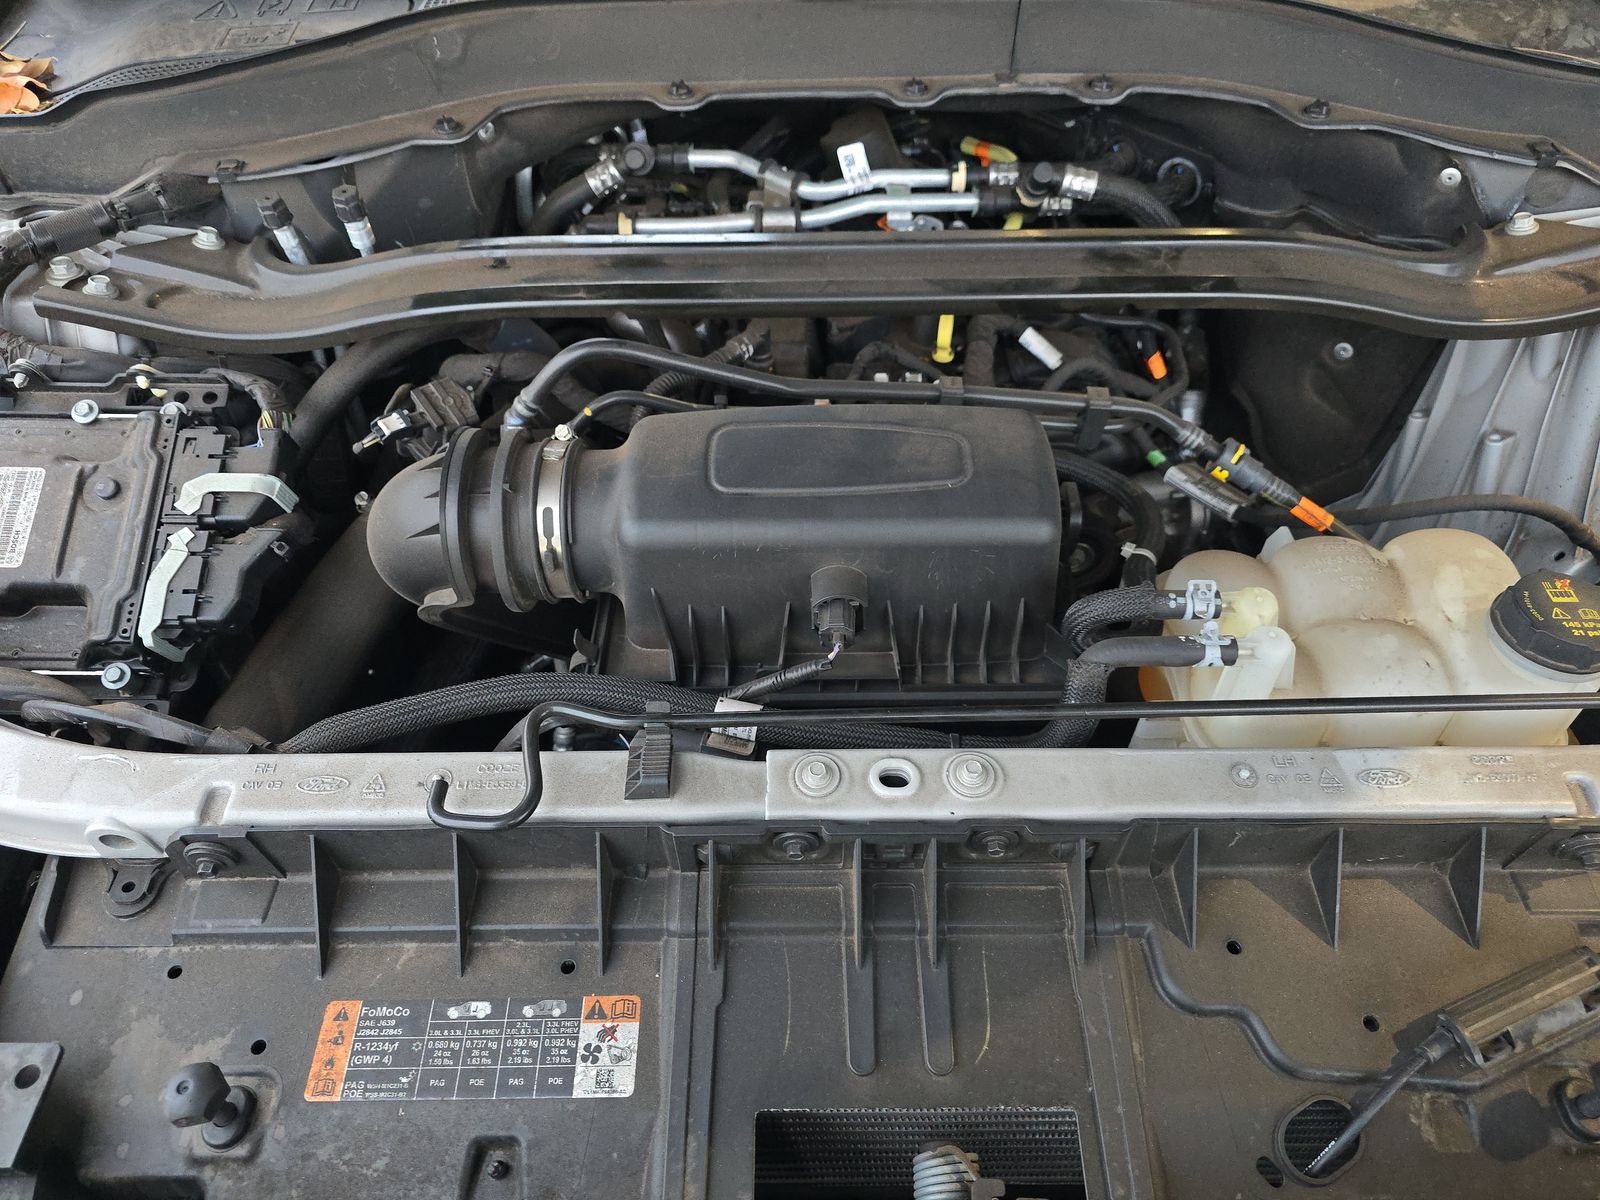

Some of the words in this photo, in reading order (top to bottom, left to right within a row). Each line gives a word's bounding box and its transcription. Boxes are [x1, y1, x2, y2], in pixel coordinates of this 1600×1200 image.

[10, 529, 21, 553] BOSCH
[1272, 755, 1297, 767] LH
[254, 762, 278, 774] RH
[1363, 768, 1406, 787] Ford
[301, 776, 346, 793] Ford
[361, 1006, 410, 1017] FoMoCo
[353, 1042, 400, 1053] R-1234yf
[449, 1040, 460, 1050] kg
[465, 1040, 487, 1049] 0.737
[487, 1040, 498, 1050] kg
[506, 1039, 527, 1048] 0.992
[528, 1039, 539, 1049] kg
[544, 1039, 566, 1047] 0.992
[566, 1038, 577, 1048] kg
[350, 1055, 381, 1066] (GWP
[382, 1055, 393, 1066] 4)
[344, 1081, 365, 1089] PAG
[429, 1079, 446, 1087] PAG
[508, 1078, 525, 1086] PAG
[548, 1077, 564, 1085] POE
[342, 1090, 364, 1098] POE
